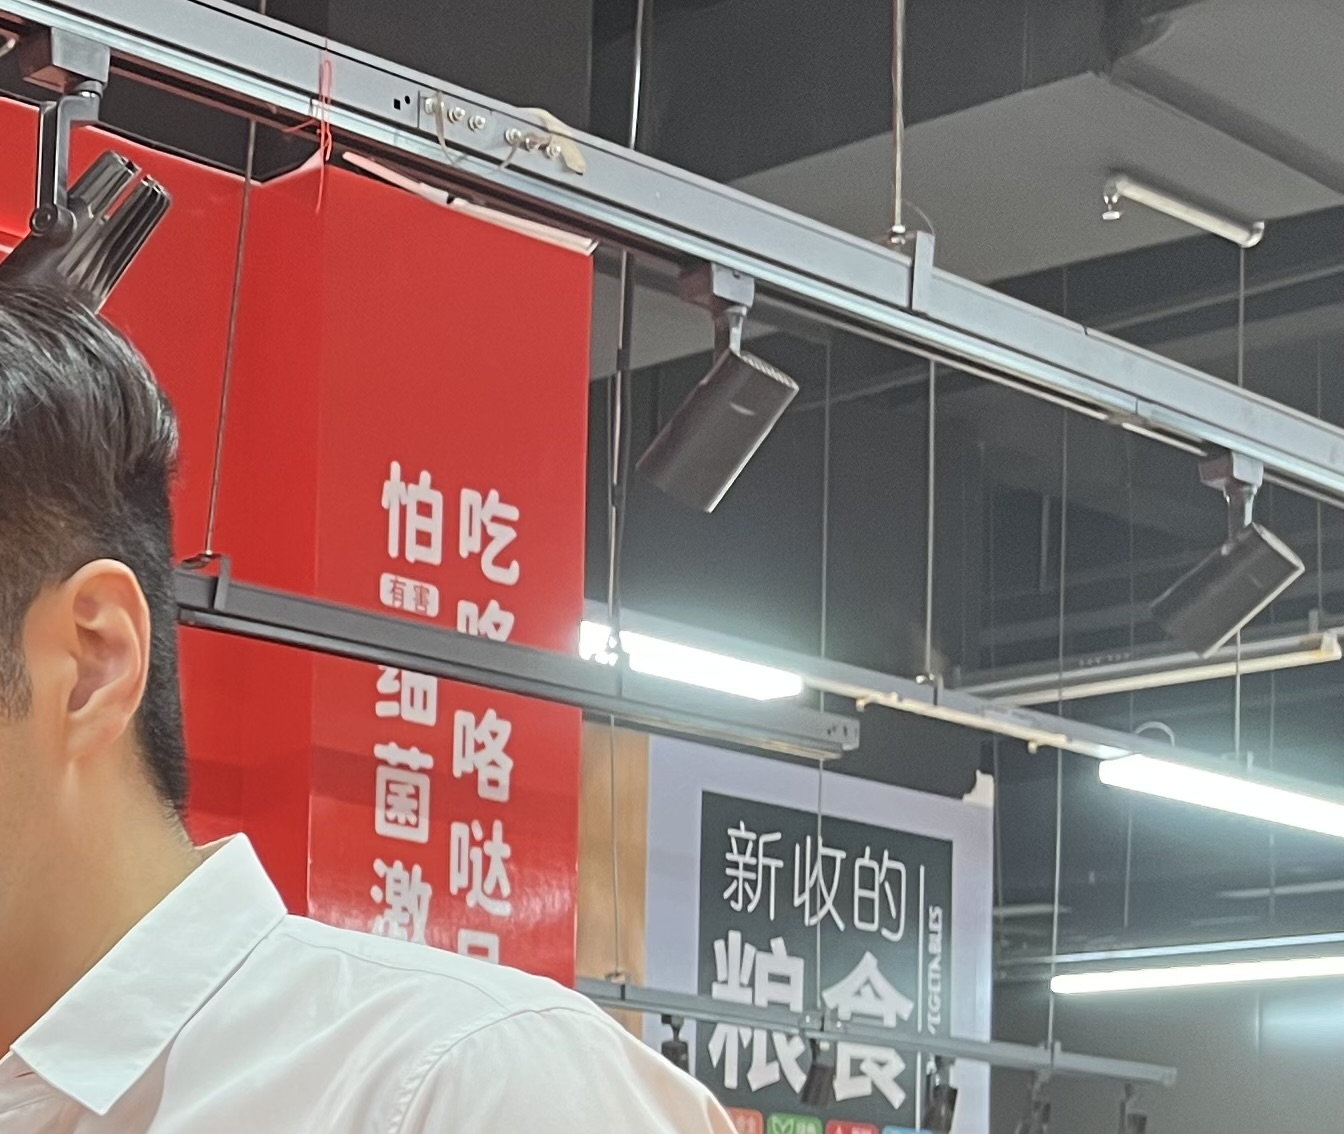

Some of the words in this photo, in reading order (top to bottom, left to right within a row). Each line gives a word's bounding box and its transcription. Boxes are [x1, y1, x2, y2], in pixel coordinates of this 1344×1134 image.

[723, 820, 907, 942] 新收的
[707, 929, 915, 1111] 粮食
